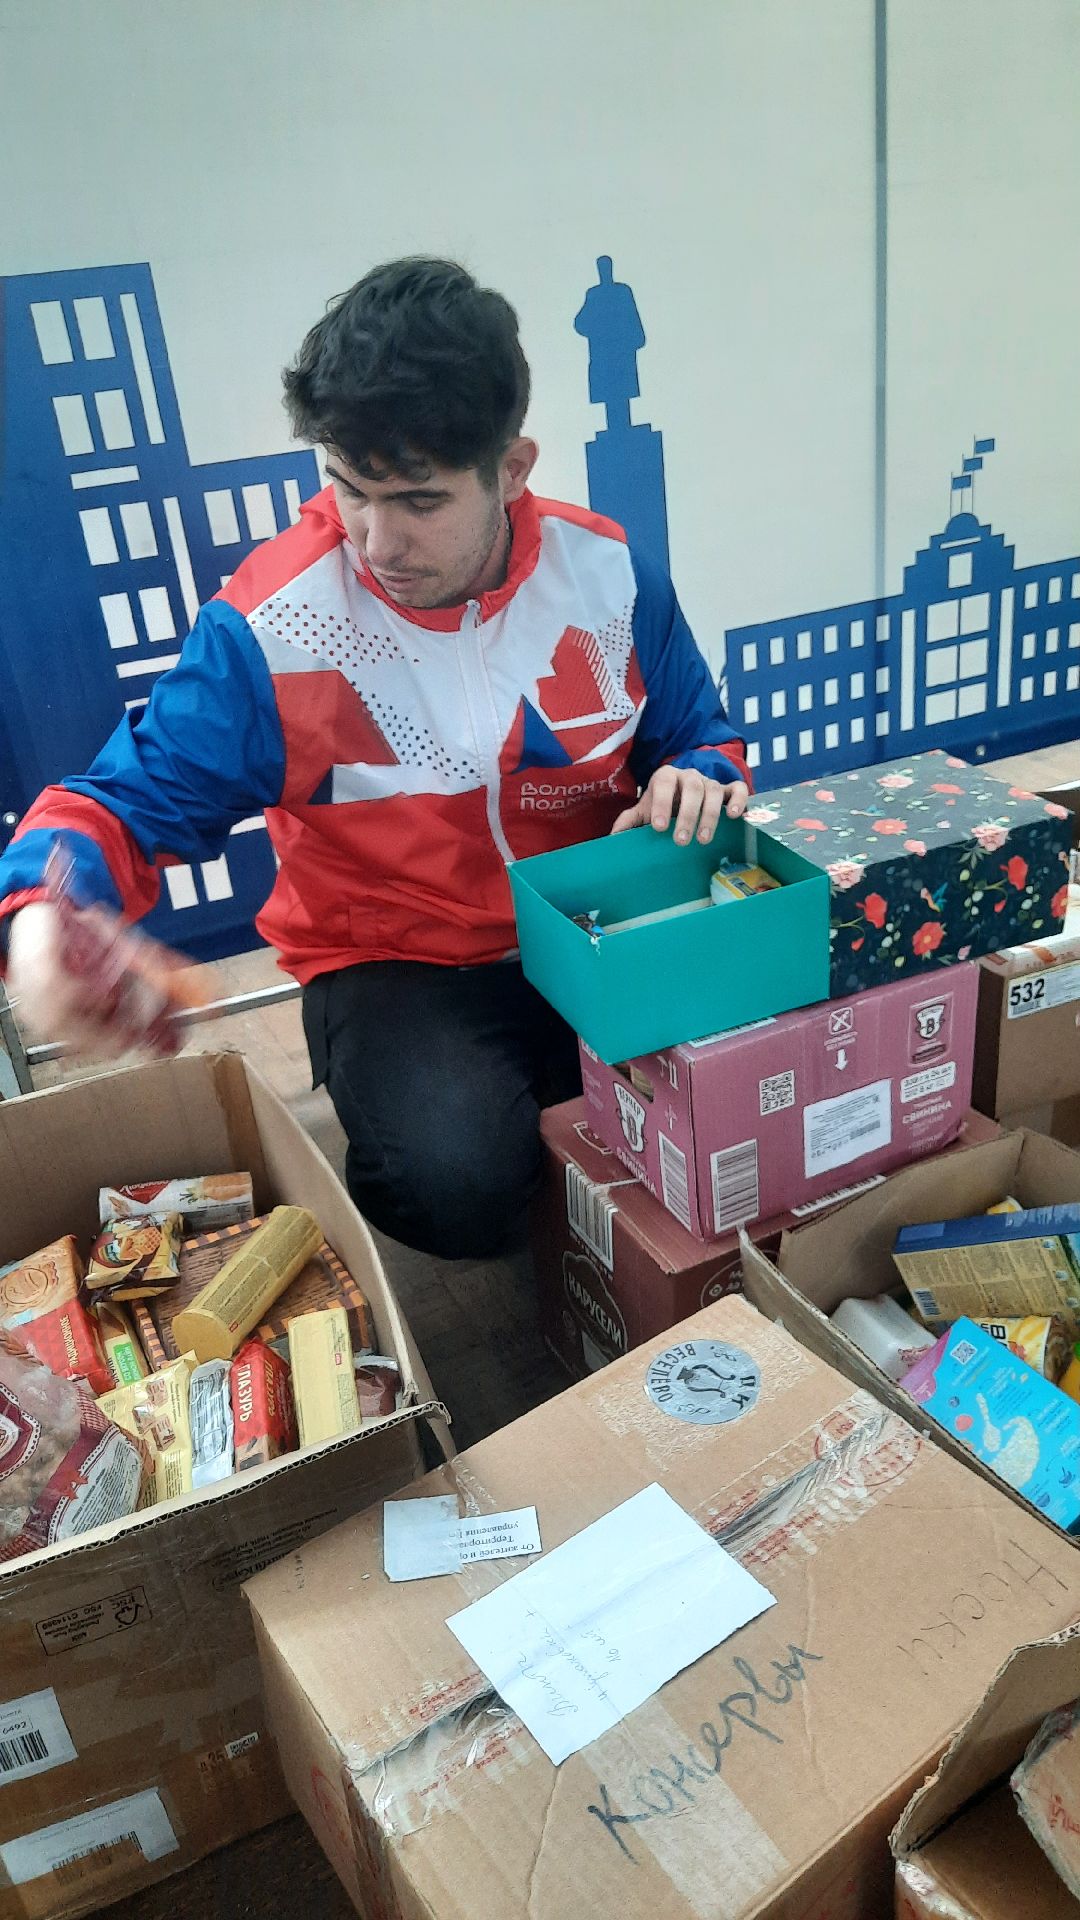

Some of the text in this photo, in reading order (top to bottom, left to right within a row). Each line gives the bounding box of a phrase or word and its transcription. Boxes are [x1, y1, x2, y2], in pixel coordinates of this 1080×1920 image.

[1009, 978, 1045, 1006] 532
[902, 1099, 953, 1124] СВИНИНА
[239, 1362, 254, 1423] ГЛАЗУРЬ
[264, 1358, 276, 1418] ГЛАЗУРЬ
